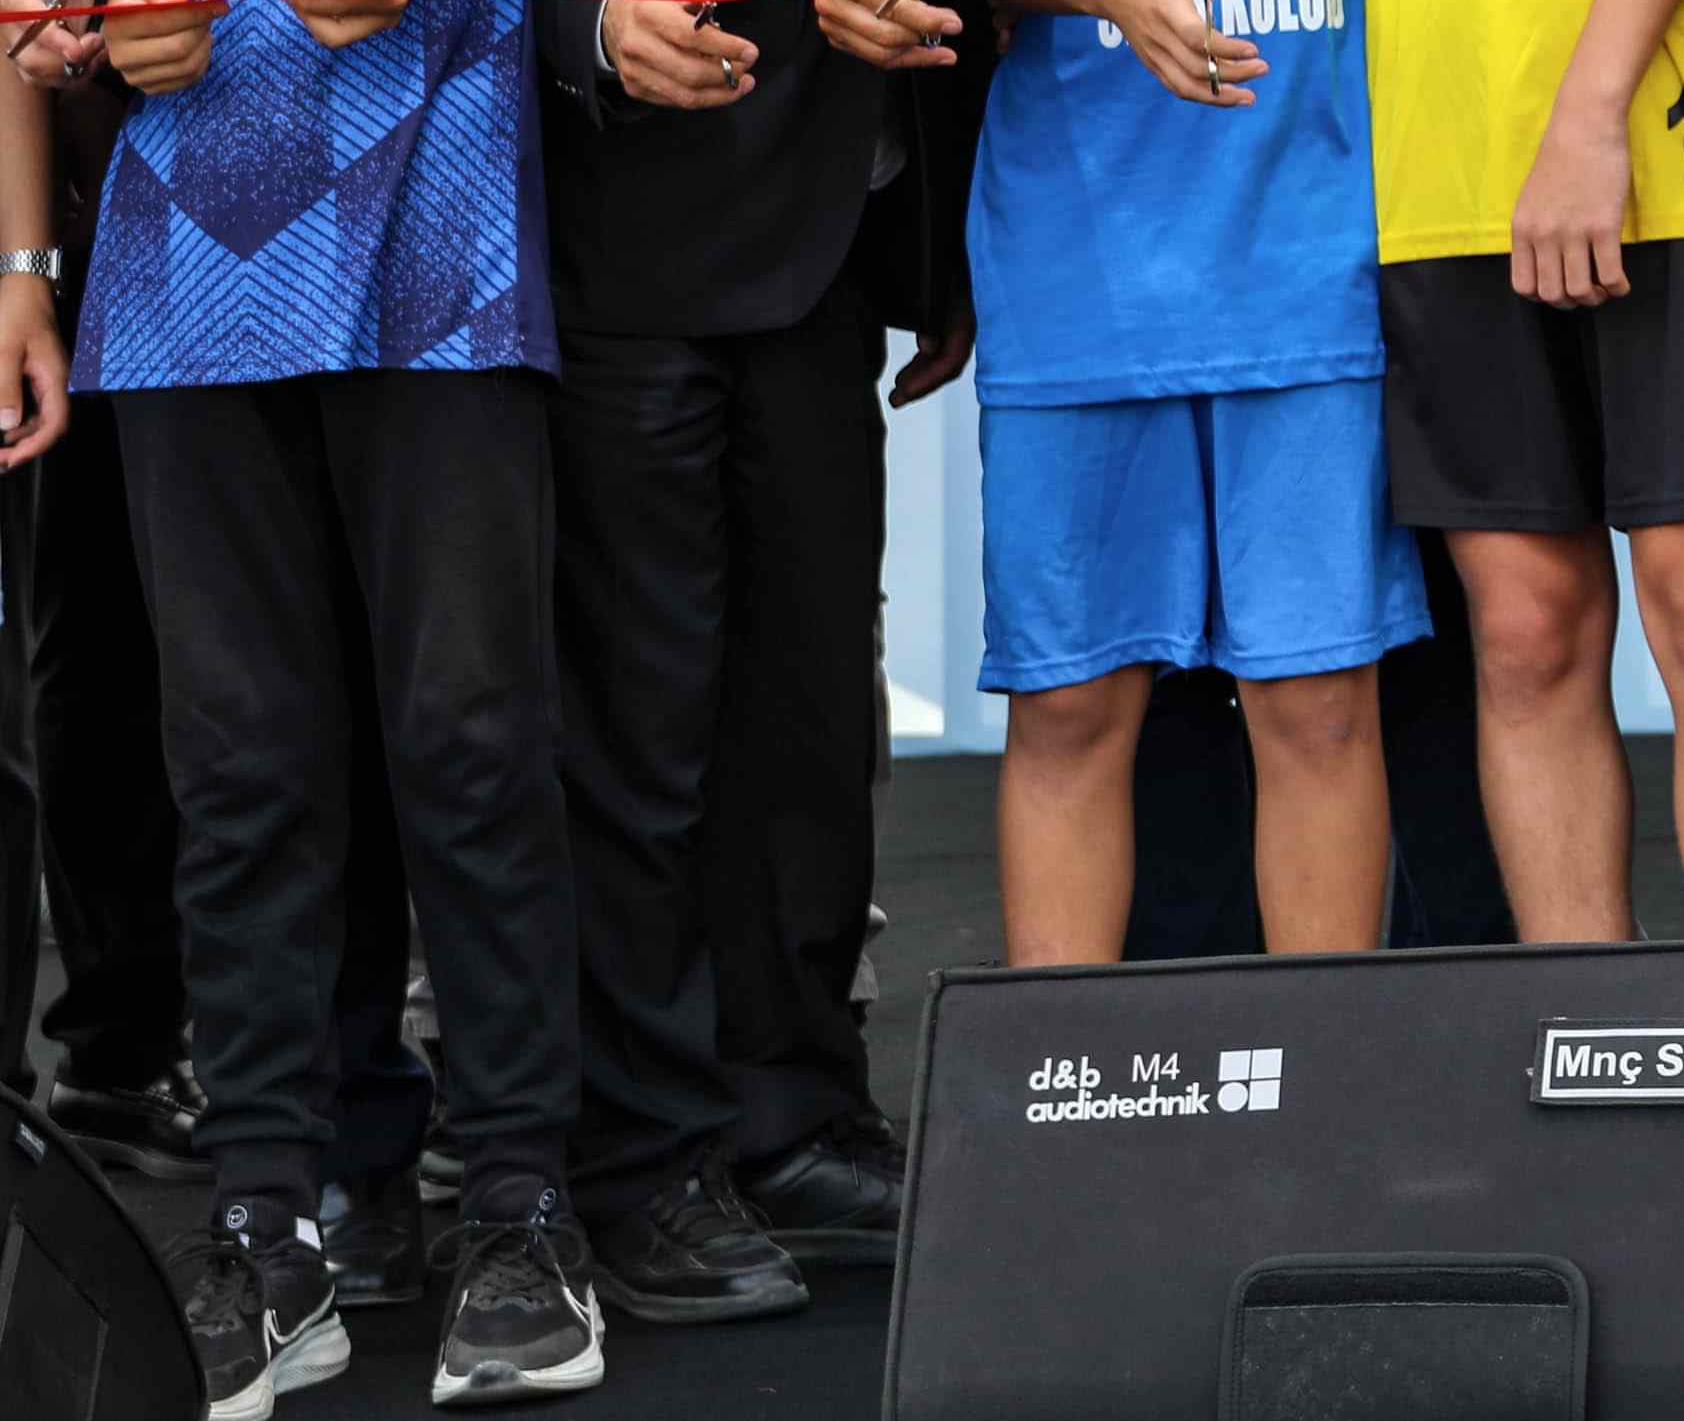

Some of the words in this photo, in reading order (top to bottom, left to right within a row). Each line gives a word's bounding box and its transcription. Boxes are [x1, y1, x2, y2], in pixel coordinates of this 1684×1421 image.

[1029, 1055, 1101, 1091] d&b
[1131, 1051, 1180, 1083] M4
[1556, 1044, 1644, 1085] Mnç
[1026, 1082, 1211, 1124] audiotechnik
